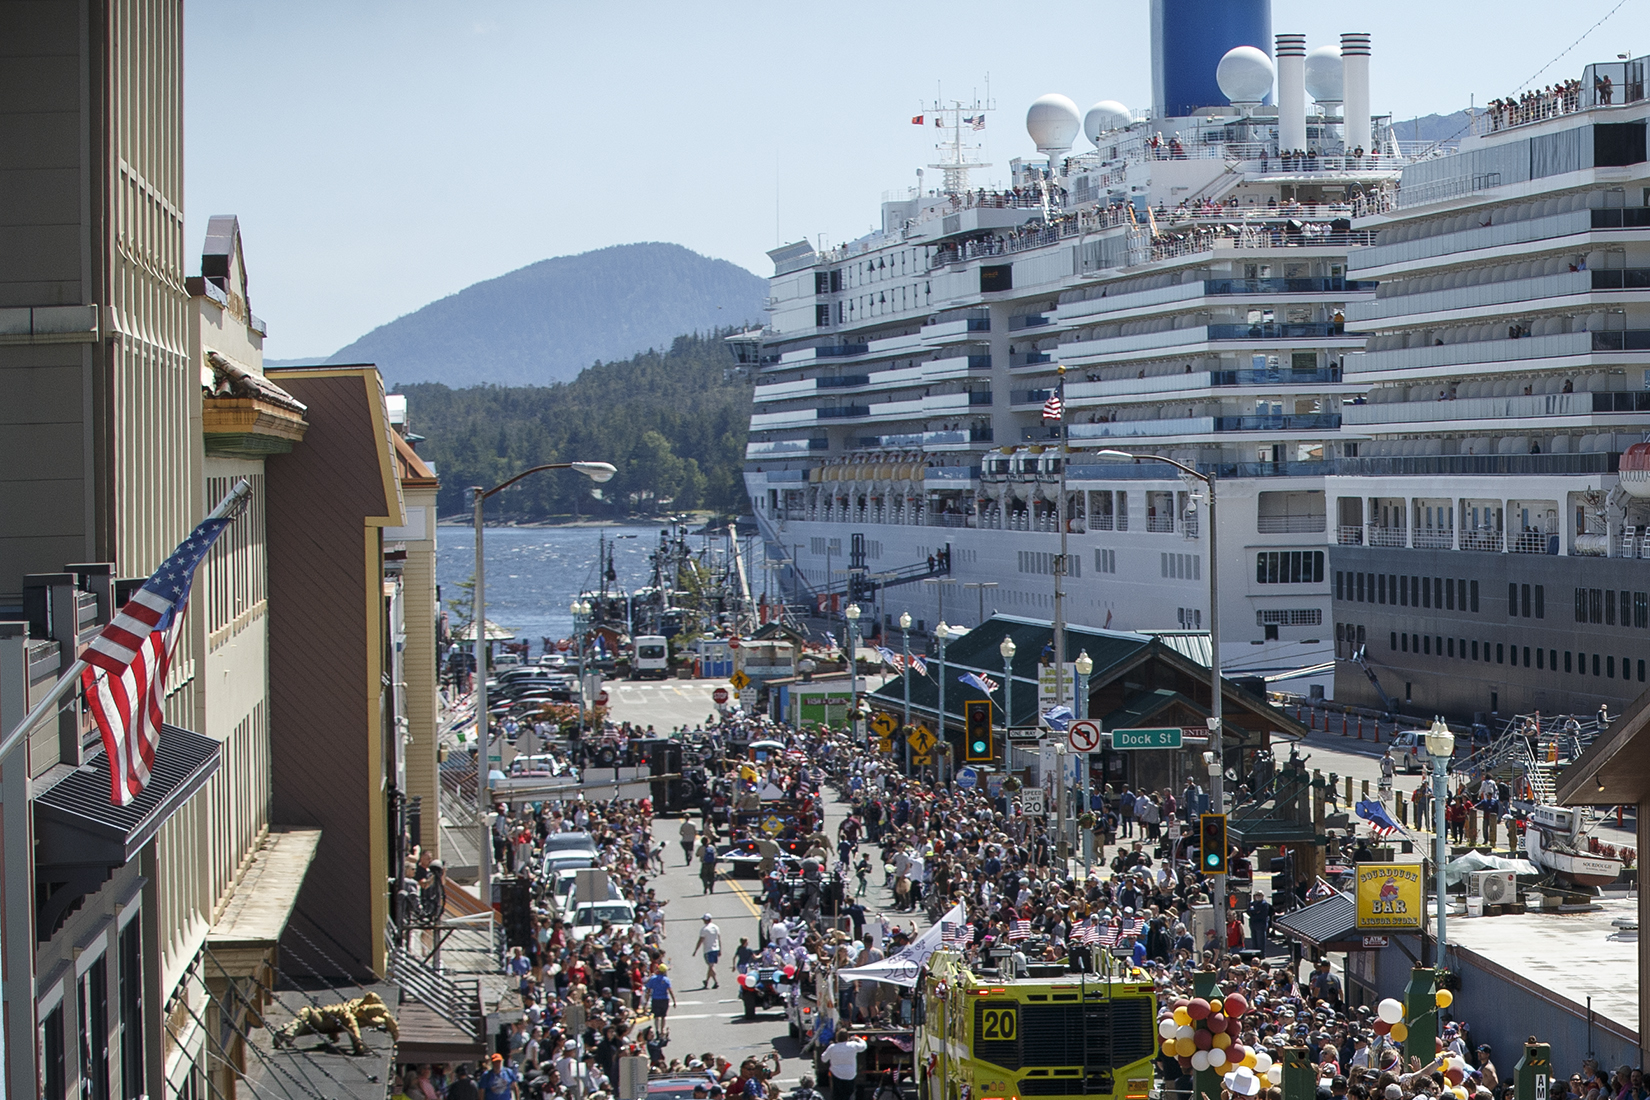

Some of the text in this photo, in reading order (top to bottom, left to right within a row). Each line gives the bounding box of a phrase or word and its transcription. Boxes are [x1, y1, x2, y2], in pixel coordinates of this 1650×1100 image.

[1122, 733, 1172, 744] Dock St
[1024, 802, 1042, 812] 20
[1360, 869, 1418, 883] SOURDOUGH
[1372, 900, 1407, 914] BAR
[1392, 917, 1418, 925] STORE
[984, 1011, 1015, 1039] 20
